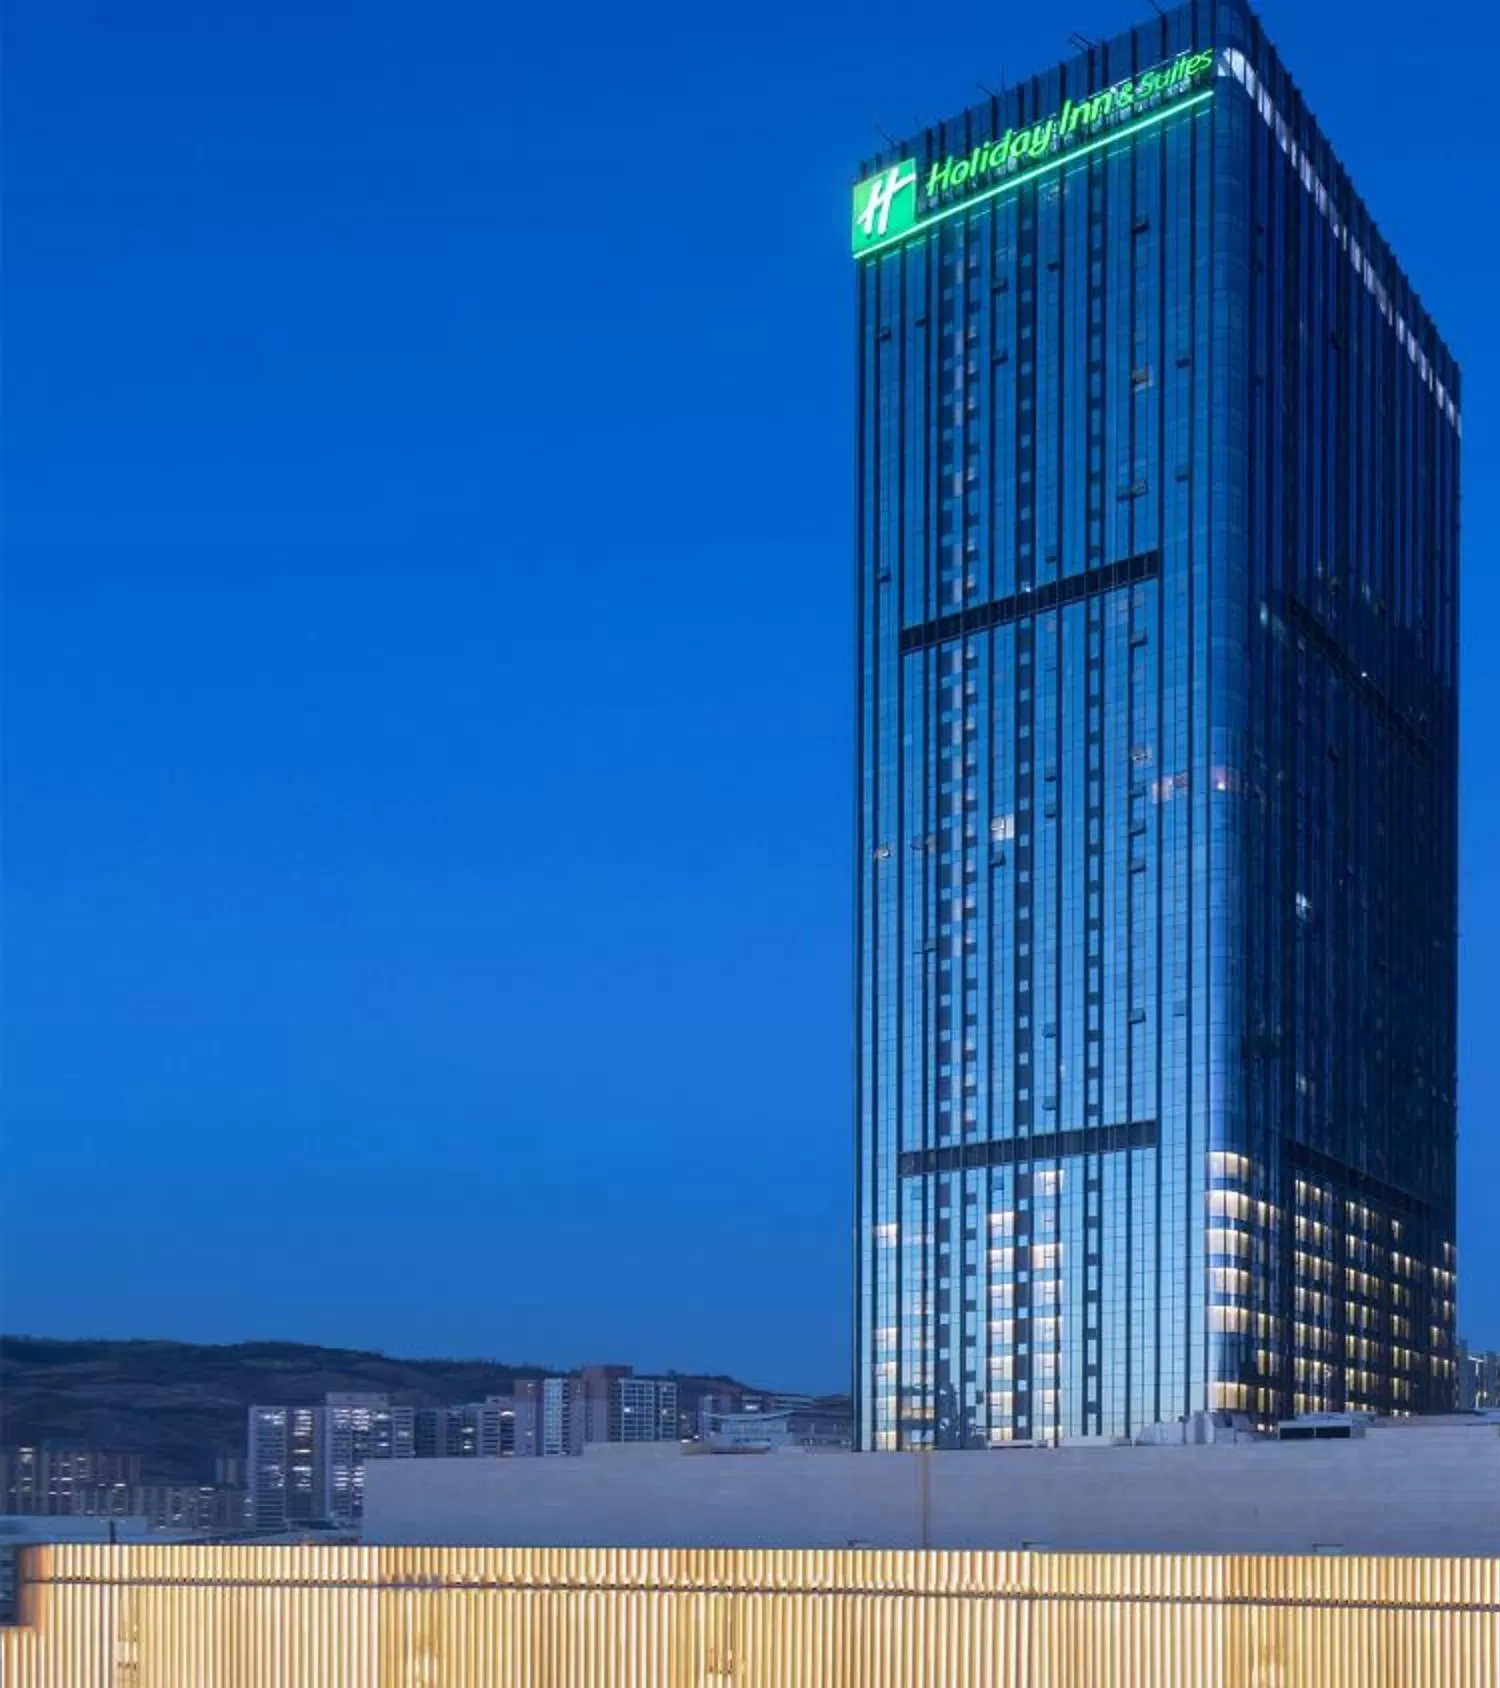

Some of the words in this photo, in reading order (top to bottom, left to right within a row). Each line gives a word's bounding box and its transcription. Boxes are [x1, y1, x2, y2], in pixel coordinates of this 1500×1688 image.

[927, 120, 1054, 197] Holiday
[1059, 92, 1114, 136] Inn
[1117, 81, 1135, 108] &
[1139, 48, 1215, 98] Suites
[857, 166, 916, 236] H
